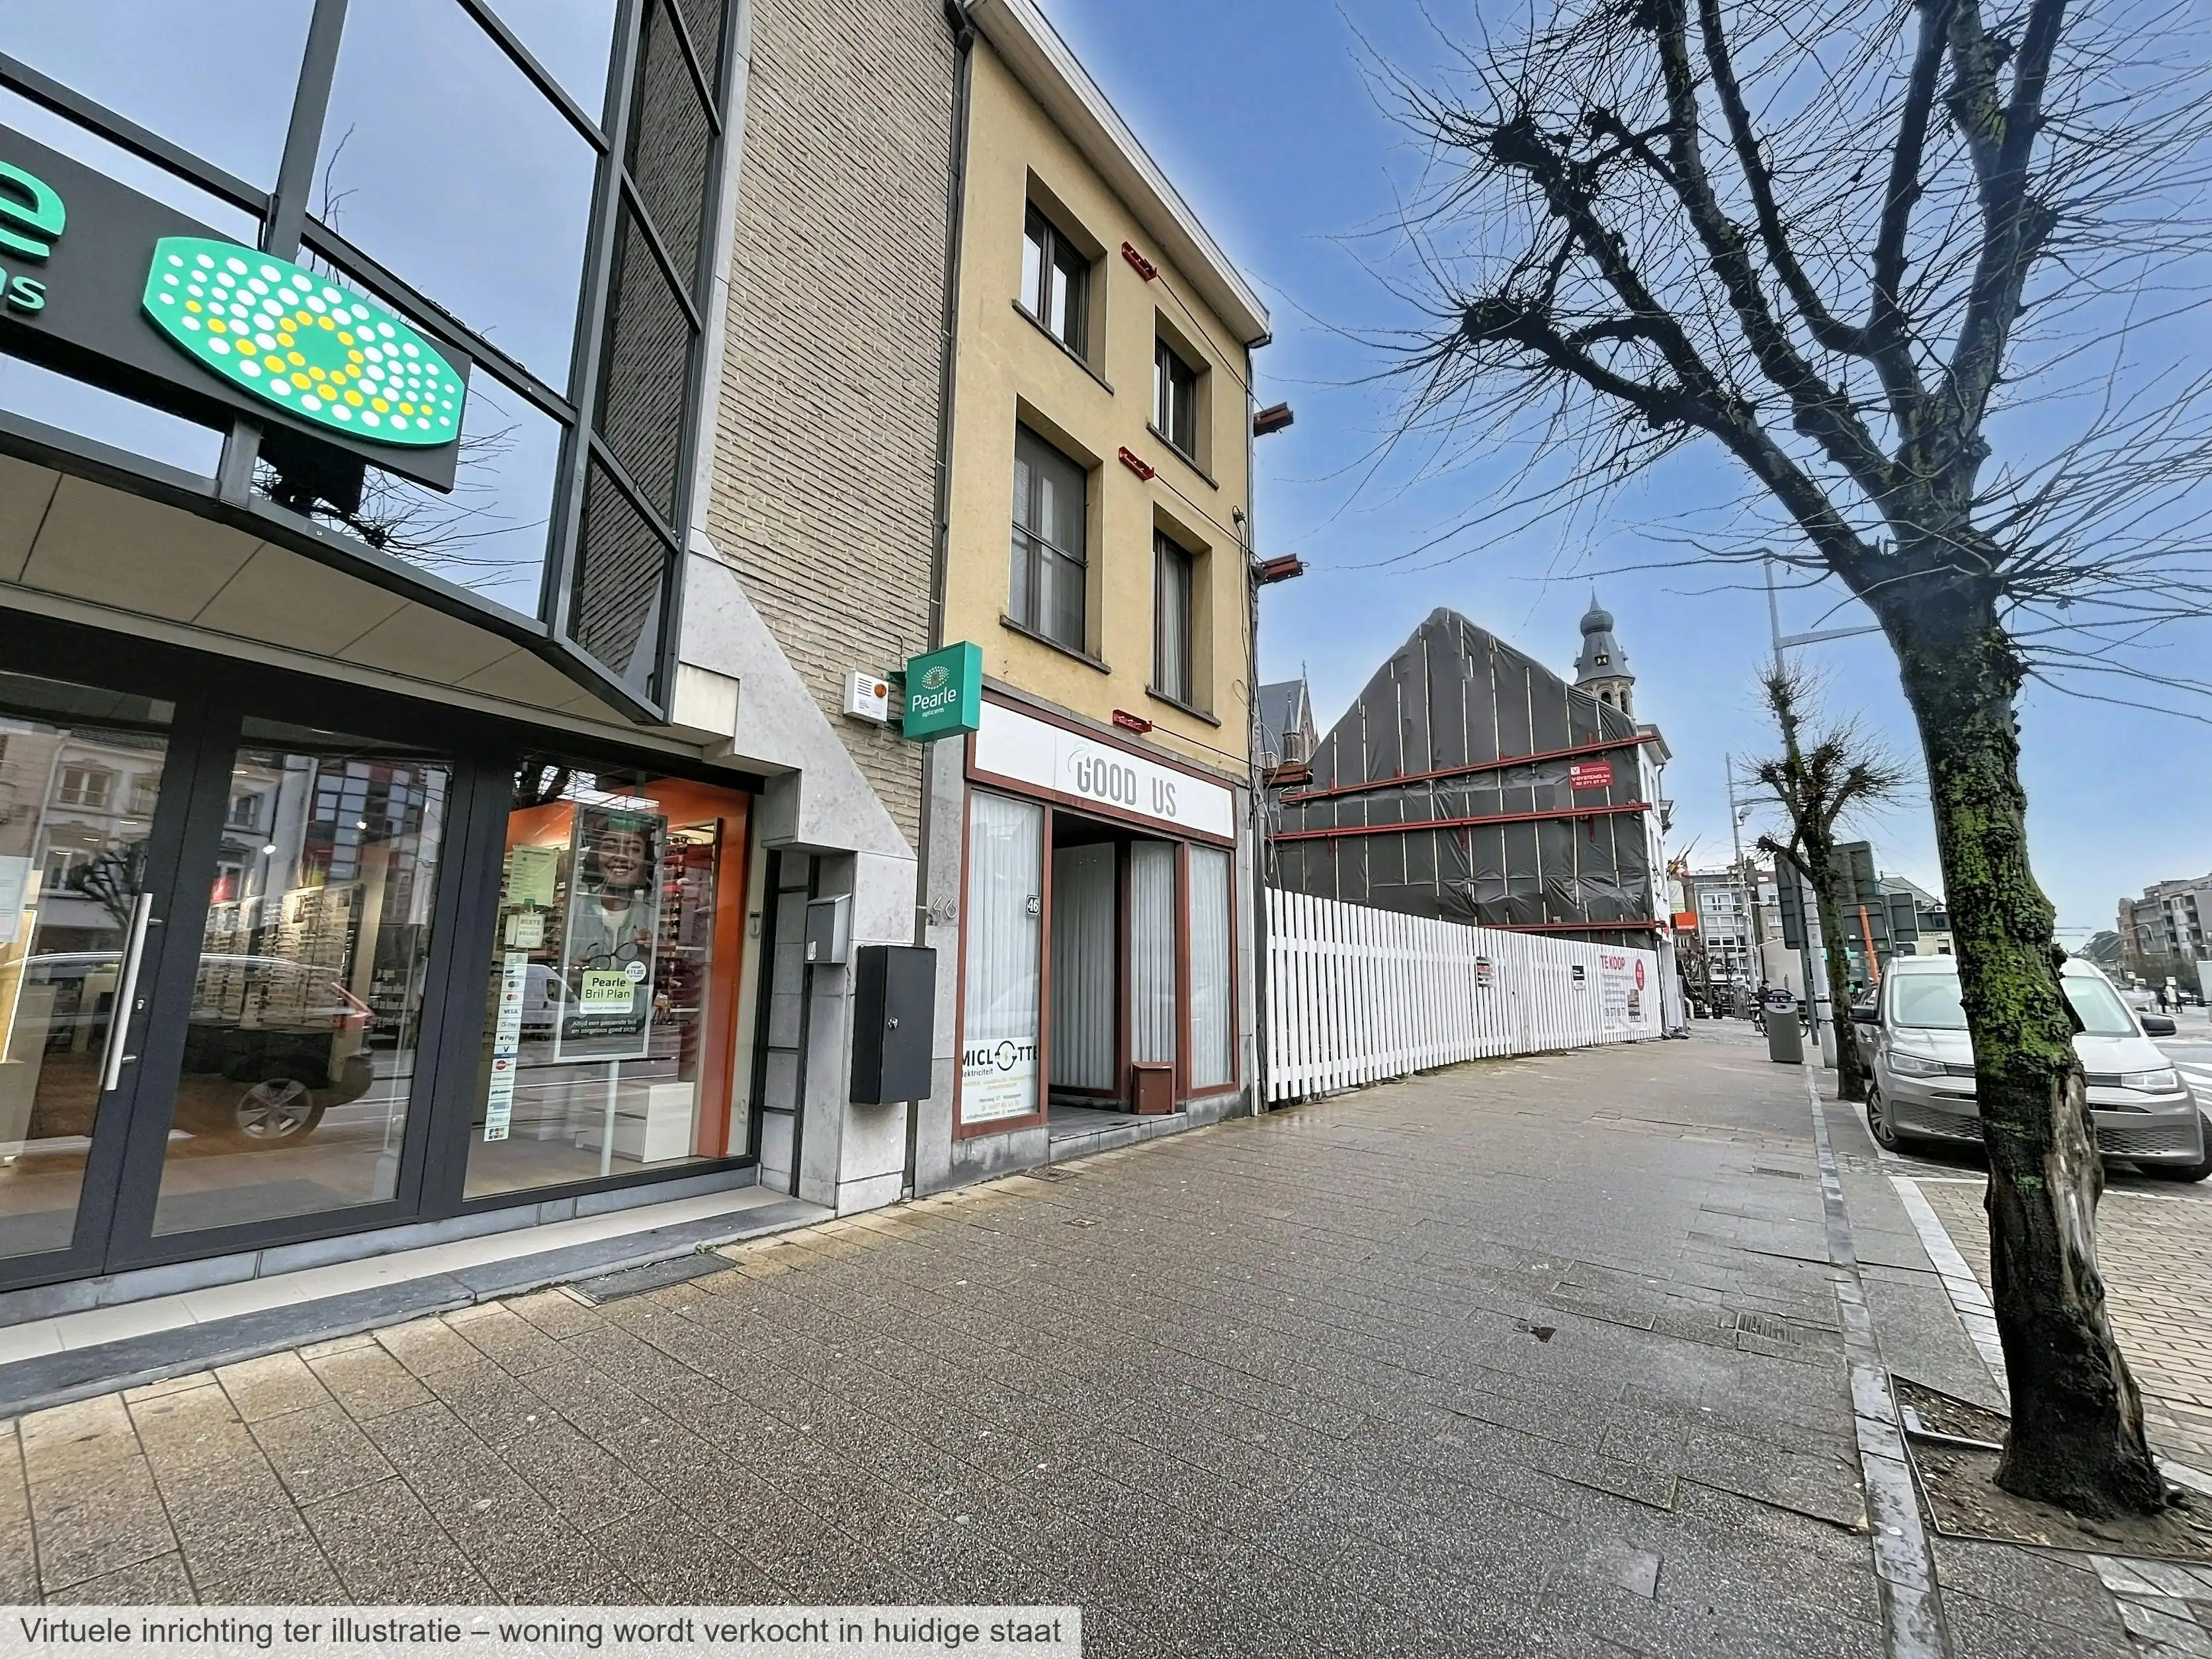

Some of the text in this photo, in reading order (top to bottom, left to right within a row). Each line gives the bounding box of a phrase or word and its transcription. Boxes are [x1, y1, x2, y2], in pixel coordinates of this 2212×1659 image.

[912, 687, 957, 712] Pearle
[922, 707, 945, 718] opticiens
[1077, 756, 1176, 817] GOOD US
[1027, 899, 1039, 913] 46
[1600, 955, 1625, 970] TE KOOP
[592, 978, 626, 987] Pearle
[585, 989, 630, 999] Bril Plan
